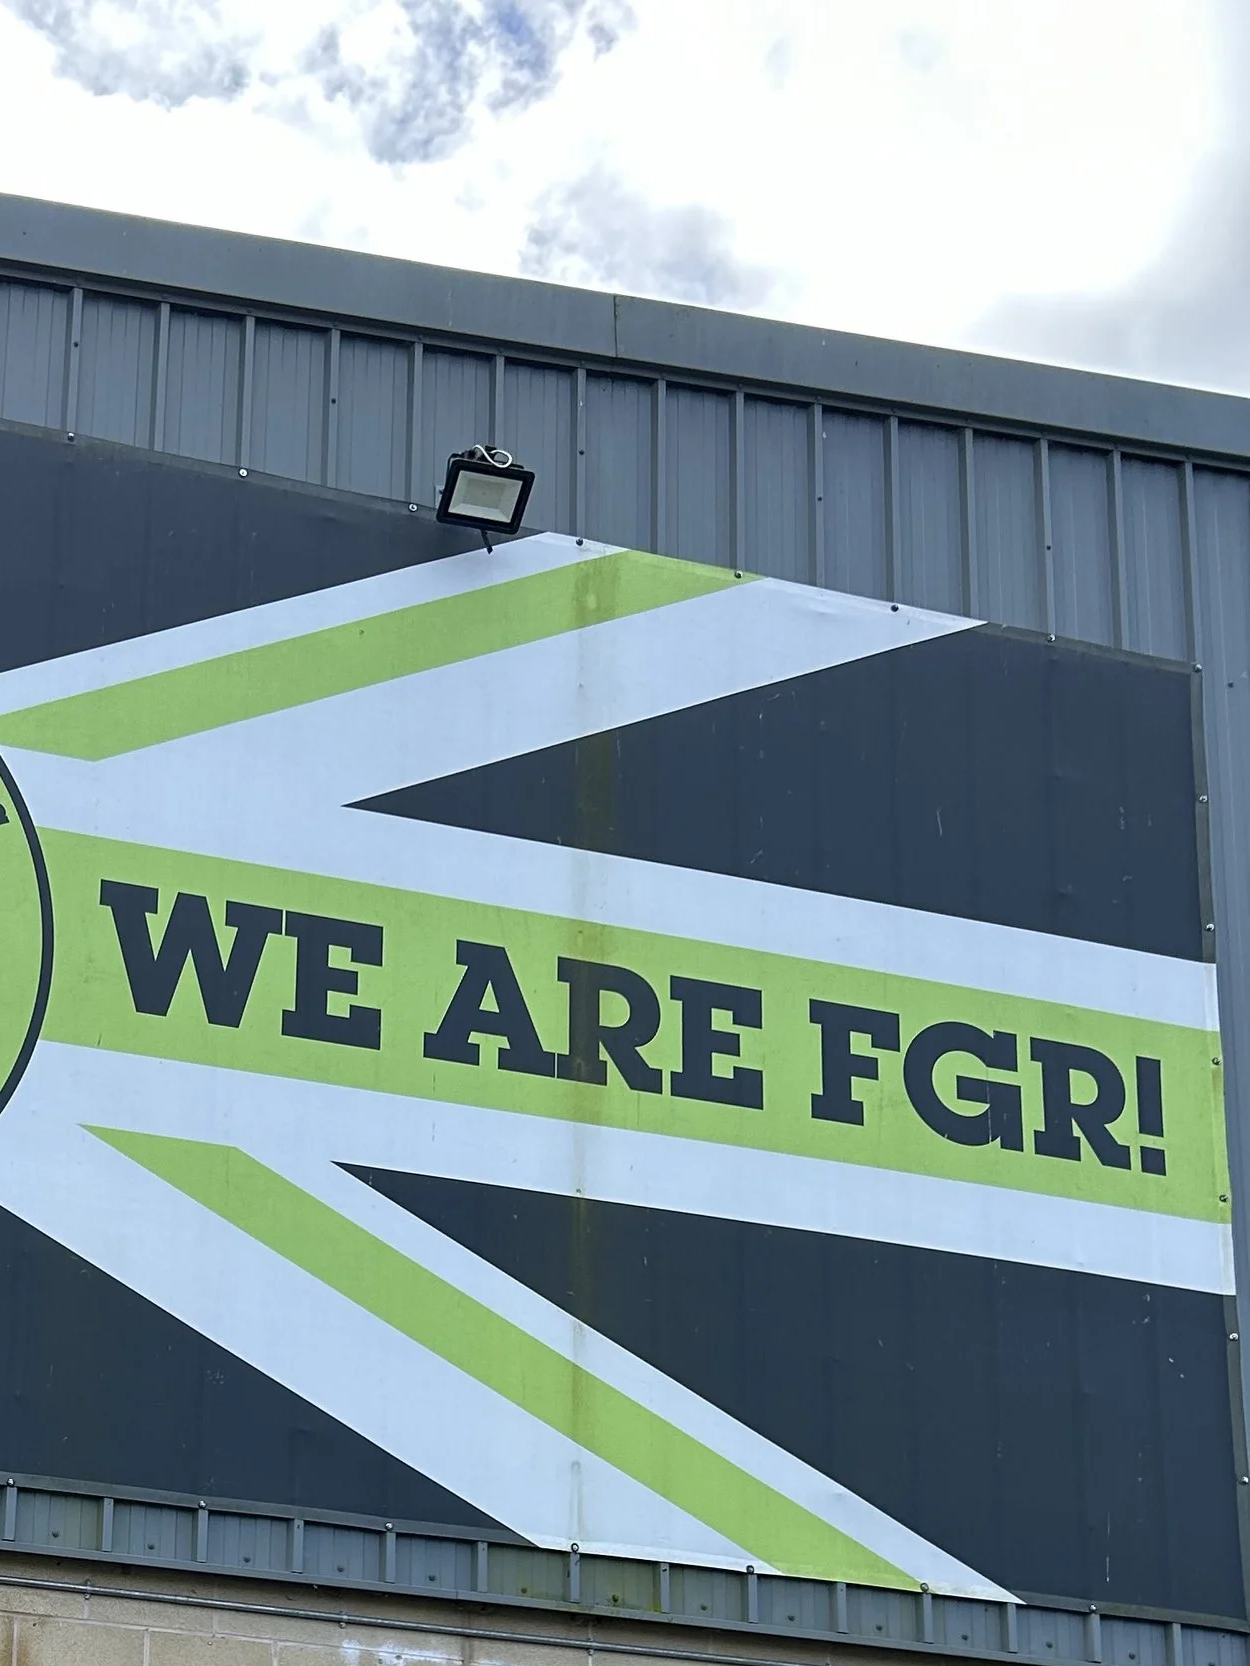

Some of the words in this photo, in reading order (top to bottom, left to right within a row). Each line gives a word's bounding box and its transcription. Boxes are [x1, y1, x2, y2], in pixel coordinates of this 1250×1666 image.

[100, 879, 384, 1051] WE
[423, 939, 763, 1109] ARE
[809, 997, 1166, 1177] FGR!
